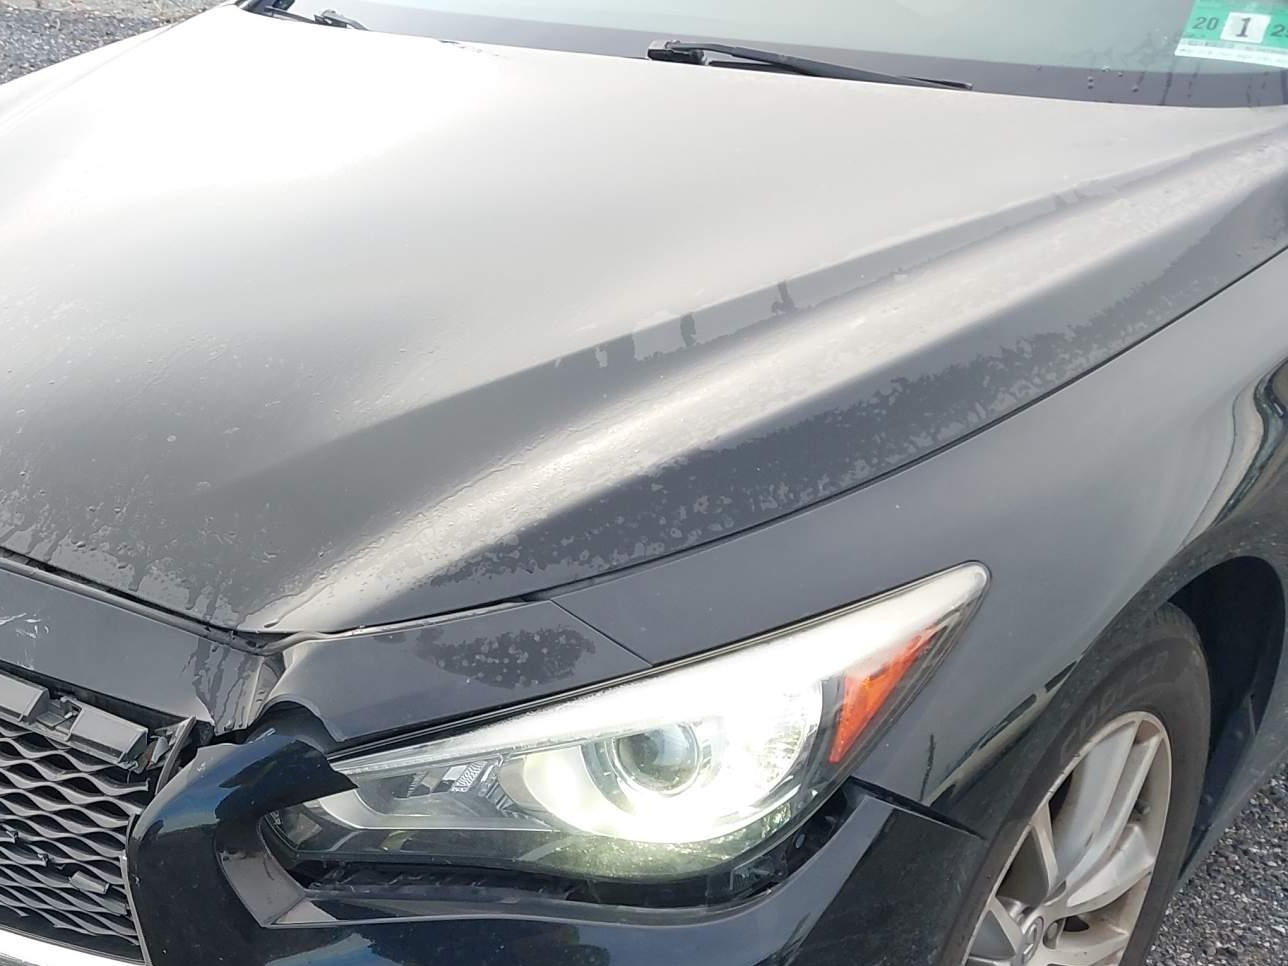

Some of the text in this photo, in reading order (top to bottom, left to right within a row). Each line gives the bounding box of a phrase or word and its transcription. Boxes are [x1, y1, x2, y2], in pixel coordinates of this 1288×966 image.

[1192, 17, 1288, 38] 20 1 2
